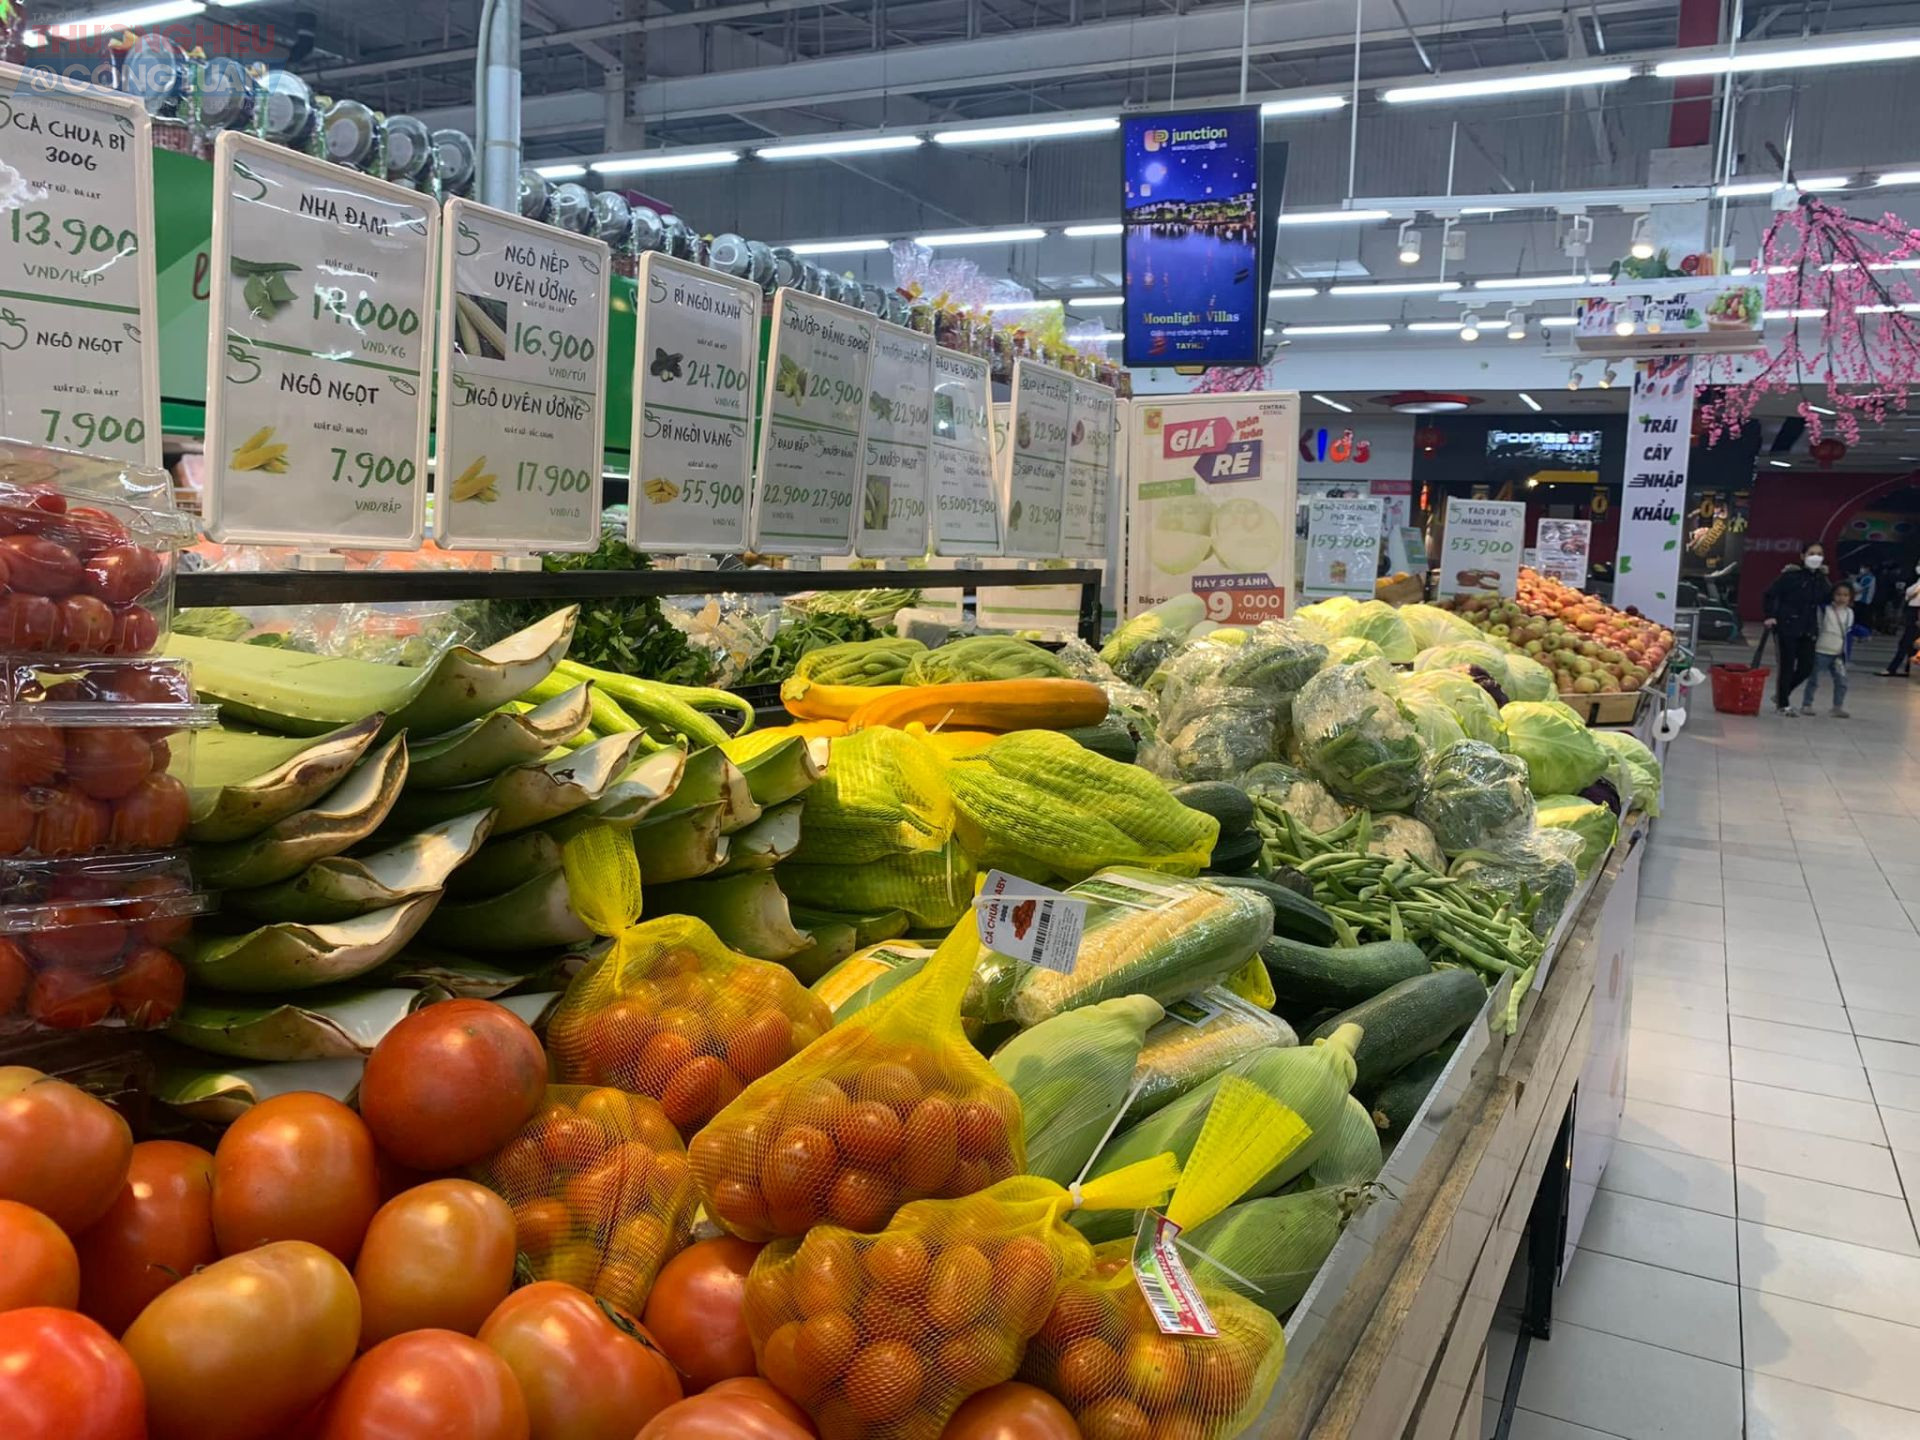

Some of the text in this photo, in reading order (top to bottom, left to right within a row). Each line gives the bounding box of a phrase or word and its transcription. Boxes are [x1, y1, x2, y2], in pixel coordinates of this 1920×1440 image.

[48, 121, 104, 148] CHUA
[1171, 126, 1228, 145] junction
[45, 146, 98, 171] 300G
[299, 193, 340, 224] NHA
[11, 208, 139, 256] 13.900
[504, 245, 536, 267] NGÔ
[494, 271, 535, 296] UYÊN
[714, 299, 741, 319] XANH
[1206, 310, 1240, 323] Villas
[36, 331, 124, 355] NGÔ NGỌT
[514, 322, 596, 362] 16.900
[686, 360, 748, 391] 24.700
[280, 372, 380, 407] NGÔ NGỌT
[465, 387, 498, 407] NGÔ
[502, 392, 542, 414] UYÊN
[808, 374, 864, 405] 20.900
[40, 408, 145, 448] 7.900
[662, 419, 672, 439] BÍ
[1169, 420, 1216, 452] GIÁ
[1643, 416, 1678, 433] TRÁI
[1211, 444, 1253, 477] RẺ
[1643, 443, 1672, 461] CÂY
[331, 447, 417, 488] 7.900
[516, 461, 591, 496] 17.900
[681, 480, 744, 509] 55.900
[1644, 471, 1684, 492] NHẬP
[763, 484, 853, 510] 22.900 27.900
[1631, 499, 1675, 521] KHẨU
[1451, 536, 1513, 554] 55.900
[1220, 578, 1235, 587] SO
[986, 902, 1000, 929] CHUA
